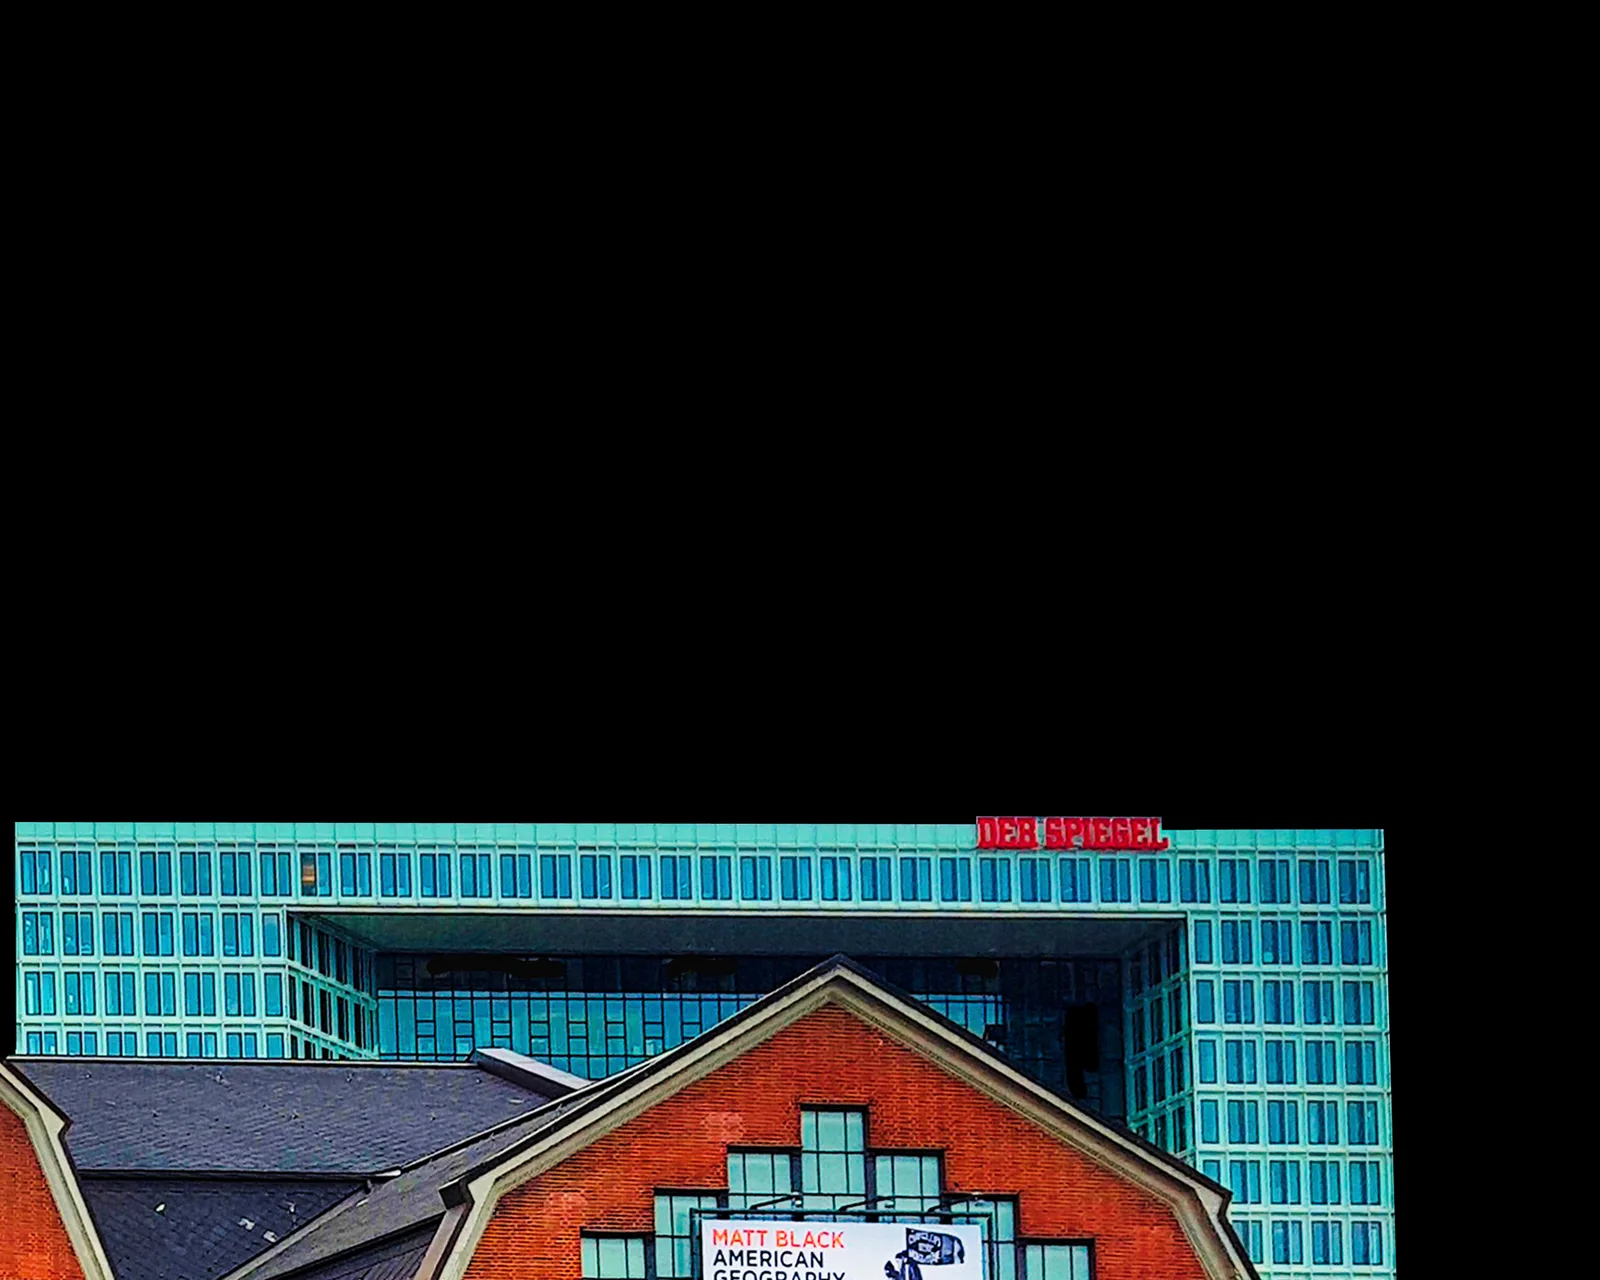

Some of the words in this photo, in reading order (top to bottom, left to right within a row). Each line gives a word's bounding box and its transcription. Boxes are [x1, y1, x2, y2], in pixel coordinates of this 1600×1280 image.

[977, 817, 1038, 849] DER
[1045, 817, 1169, 850] SPIEGEL
[713, 1229, 768, 1248] MATT
[776, 1230, 845, 1249] BLACK
[713, 1250, 824, 1269] AMERICAN
